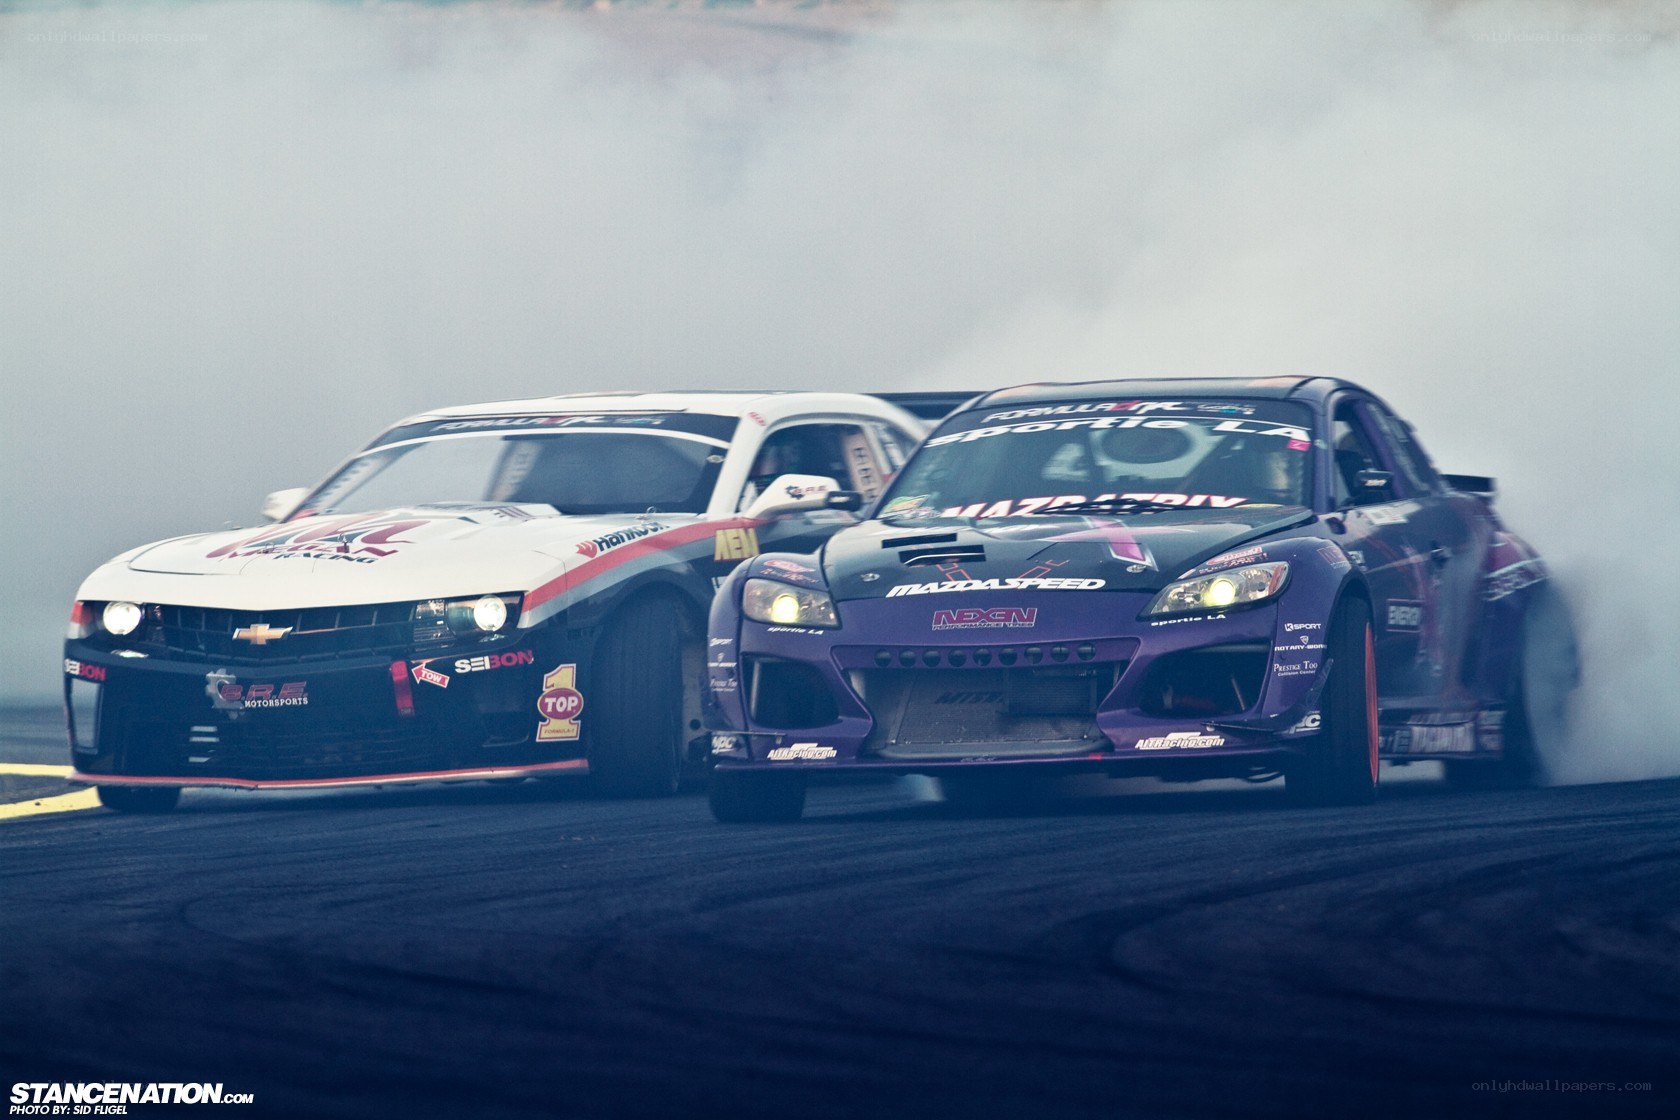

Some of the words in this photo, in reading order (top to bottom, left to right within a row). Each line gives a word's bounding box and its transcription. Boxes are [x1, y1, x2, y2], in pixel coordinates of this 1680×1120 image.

[923, 416, 1189, 448] sportie
[1212, 420, 1311, 442] LA
[714, 528, 760, 562] AEM
[272, 551, 379, 564] RACING
[885, 578, 1107, 598] MAZDASPEED
[933, 608, 1038, 626] NEXEN
[1151, 616, 1203, 627] sportie
[1206, 613, 1226, 621] LA
[767, 626, 804, 635] sportie
[932, 622, 1003, 631] PERFORMANCE
[64, 658, 107, 681] SEIBON
[455, 649, 534, 674] SEIBON
[421, 669, 442, 684] TOW
[244, 697, 309, 709] MOTORSPORTS
[544, 696, 579, 713] TOP
